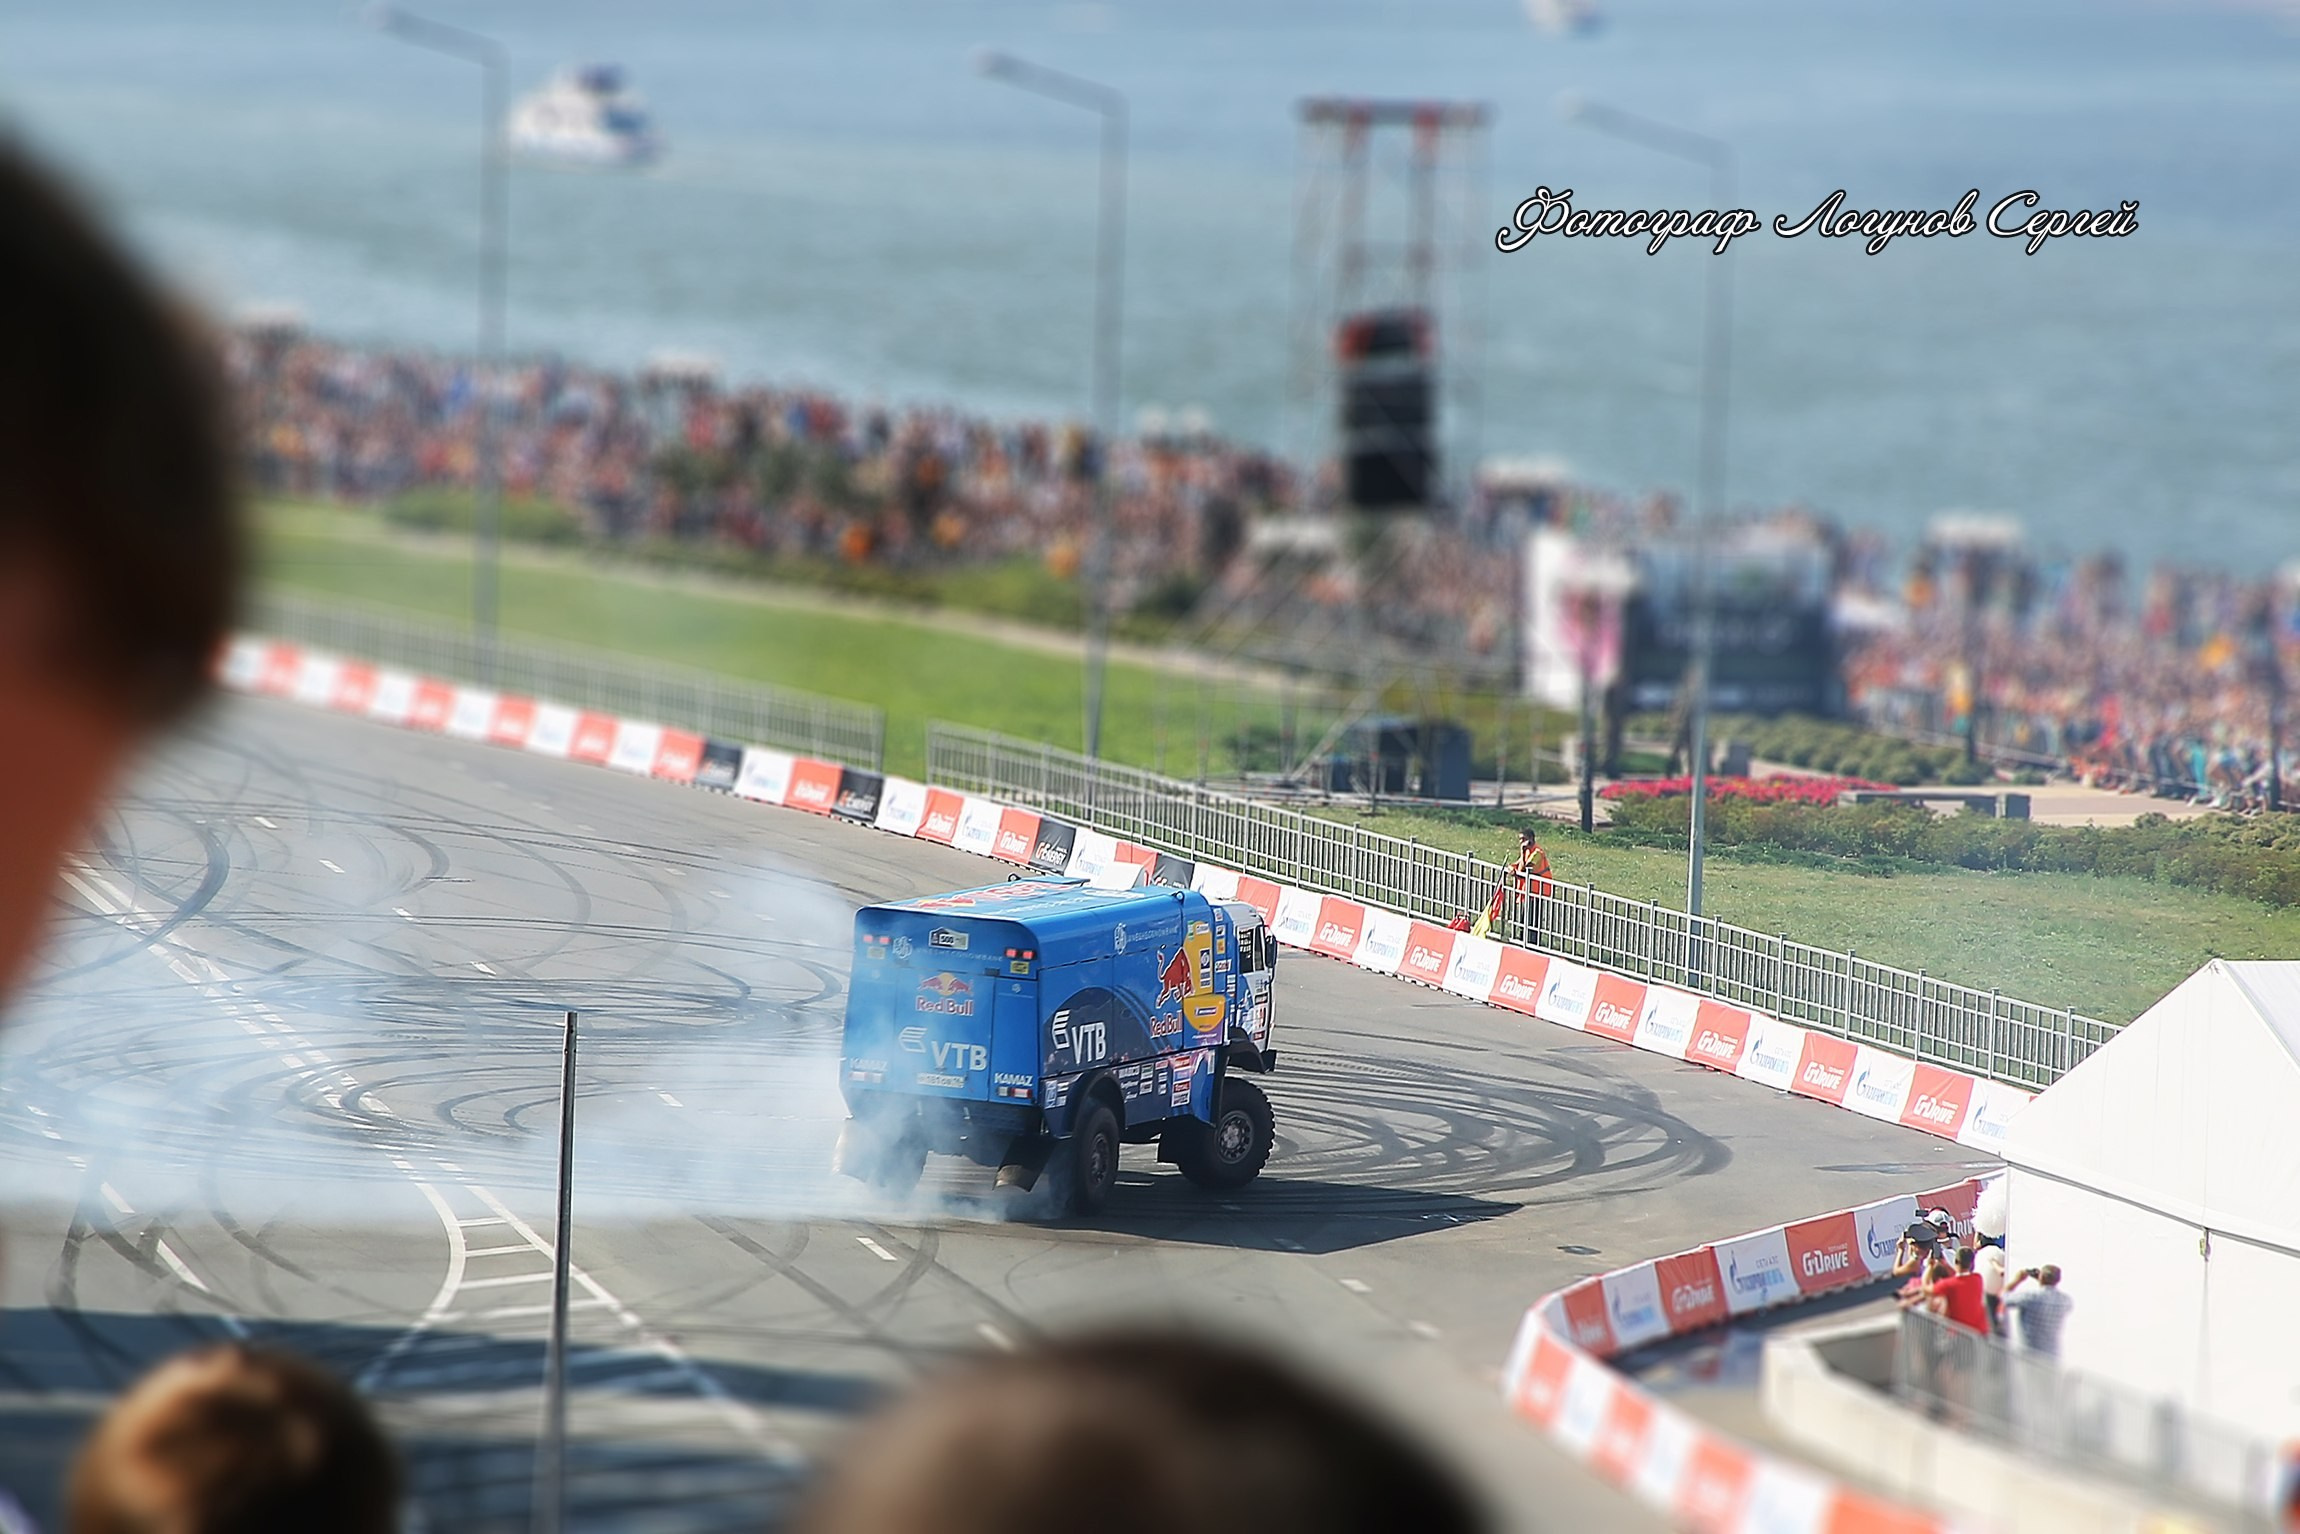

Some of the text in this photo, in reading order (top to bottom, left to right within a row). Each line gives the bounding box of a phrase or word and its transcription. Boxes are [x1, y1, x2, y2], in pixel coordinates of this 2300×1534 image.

[915, 996, 974, 1016] Red Bull
[1150, 1010, 1183, 1039] Red Bull
[931, 1040, 988, 1071] VTB
[1071, 1022, 1107, 1065] VTB
[994, 1072, 1034, 1087] KAMAZ
